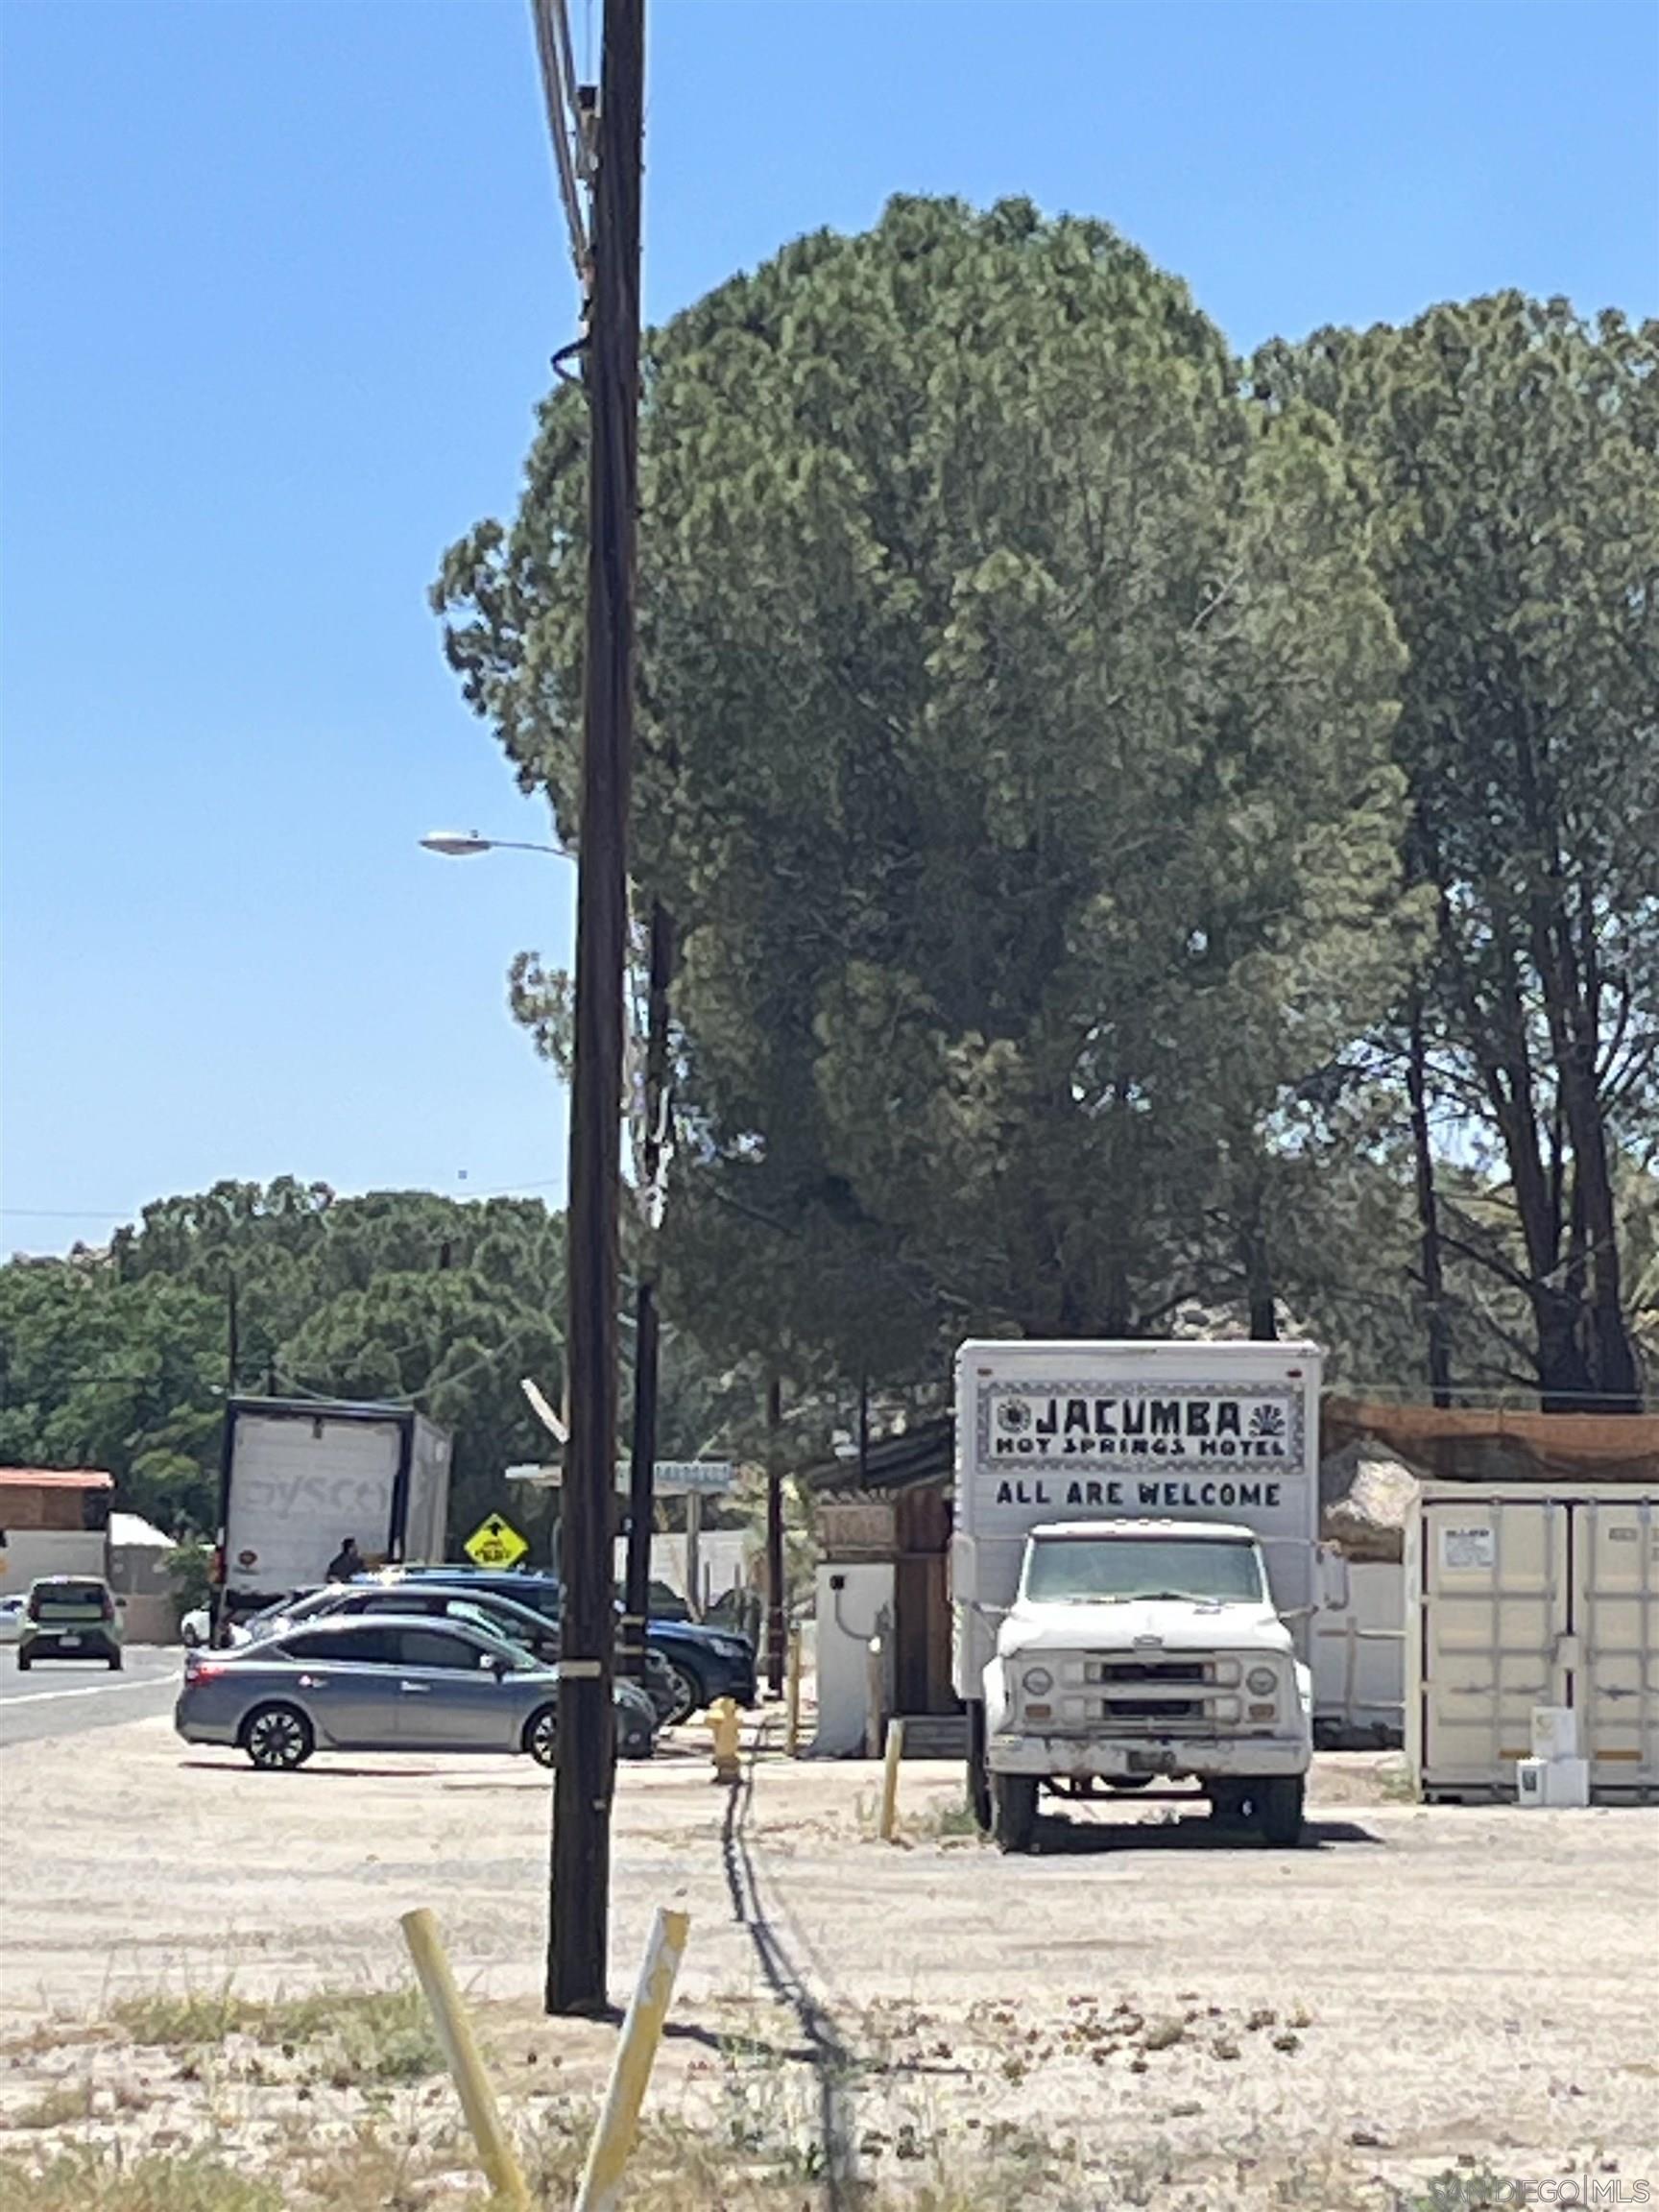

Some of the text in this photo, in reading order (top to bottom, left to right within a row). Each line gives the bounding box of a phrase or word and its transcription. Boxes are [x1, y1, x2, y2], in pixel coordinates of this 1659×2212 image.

[1036, 1398, 1241, 1436] JACUMBA
[997, 1438, 1286, 1456] HOT SPRINGS HOTEL
[997, 1481, 1281, 1505] ALL ARE WELCOME
